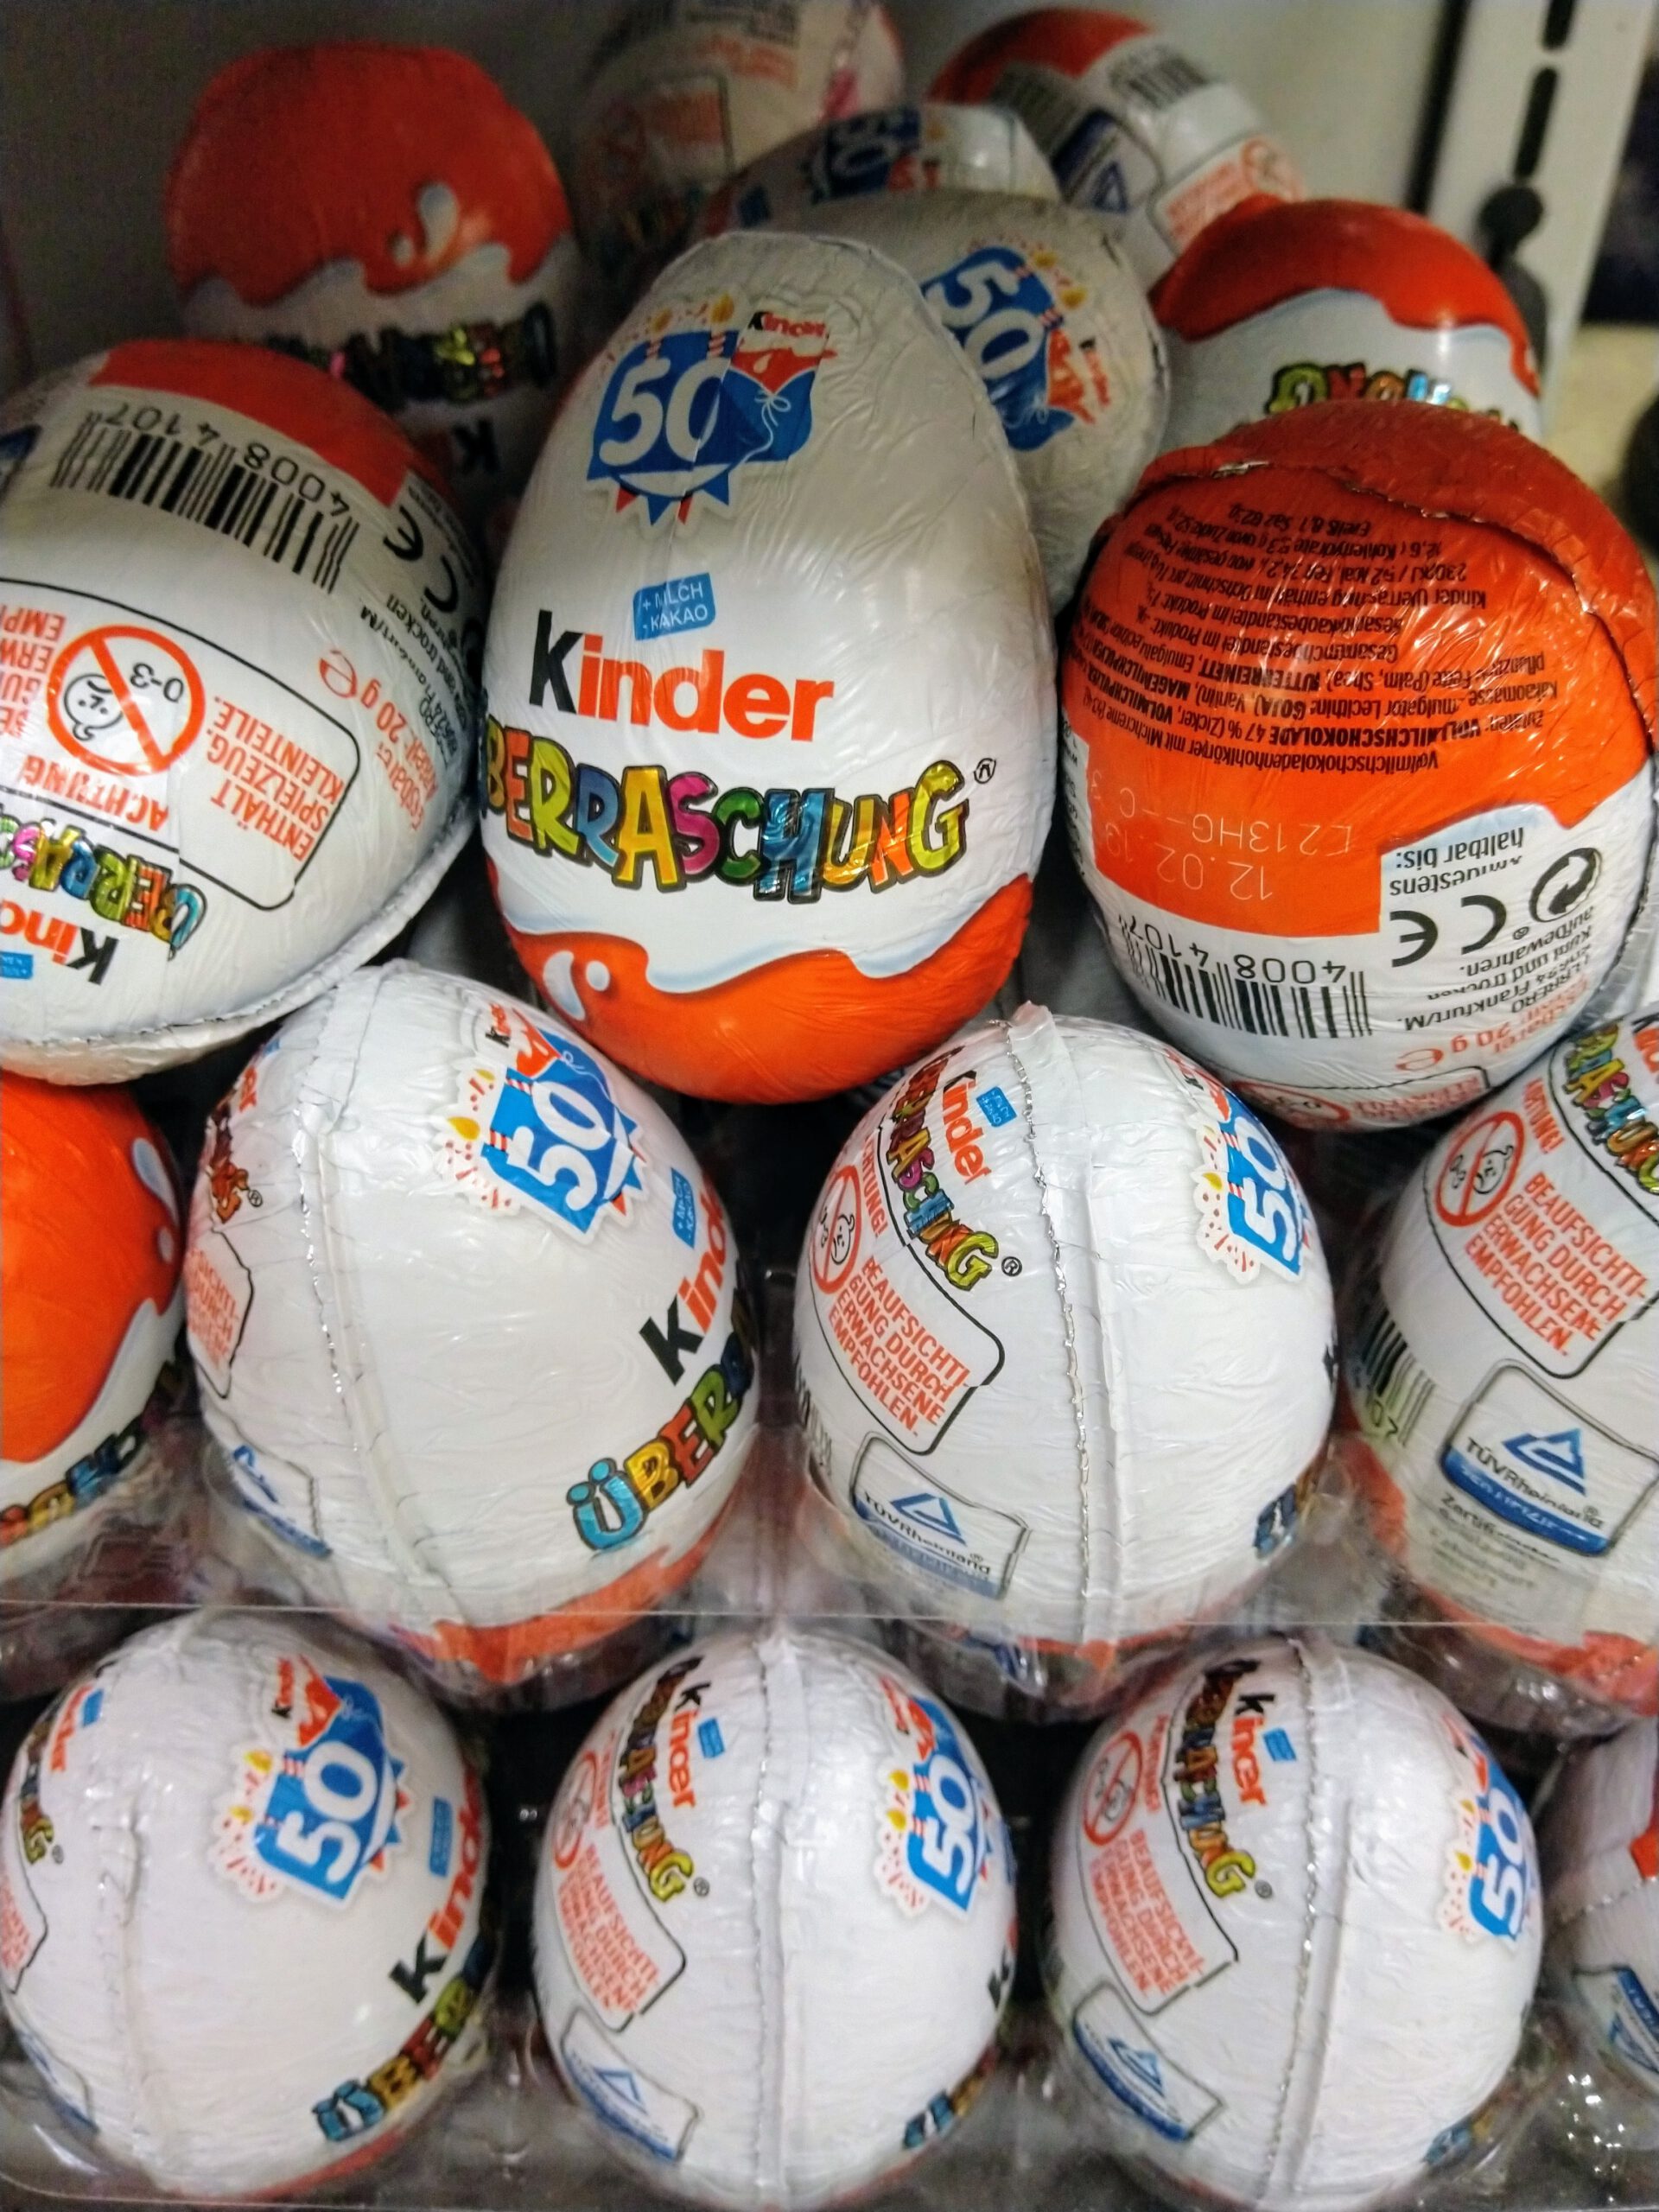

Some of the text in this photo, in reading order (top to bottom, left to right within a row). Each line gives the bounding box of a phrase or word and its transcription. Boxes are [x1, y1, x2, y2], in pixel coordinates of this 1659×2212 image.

[927, 262, 1041, 378] 50
[600, 355, 730, 467] 50
[529, 608, 836, 743] Kinder
[207, 729, 330, 831] SPIELZEUG.
[212, 696, 346, 805] KLEINTEILE.
[481, 715, 969, 904] BERRASCHUNG
[211, 785, 316, 861] ENTHÄLT
[1395, 826, 1523, 869] haltbar bis:
[1236, 954, 1347, 984] 4008
[1396, 977, 1532, 1033] Frankfurt/M.
[1510, 953, 1549, 982] und
[505, 1082, 613, 1211] 50
[1239, 1130, 1299, 1263] 50
[1464, 1233, 1569, 1357] EMPFOHLEN.
[1503, 1192, 1629, 1324] GUNG DURCH
[1523, 1171, 1649, 1302] BEAUFSICHTI-
[835, 1289, 946, 1427] ERWACHSENE
[849, 1274, 888, 1331] GUNG
[276, 1739, 378, 1883] 50
[921, 1752, 978, 1897] 50
[1476, 1799, 1526, 1930] 50
